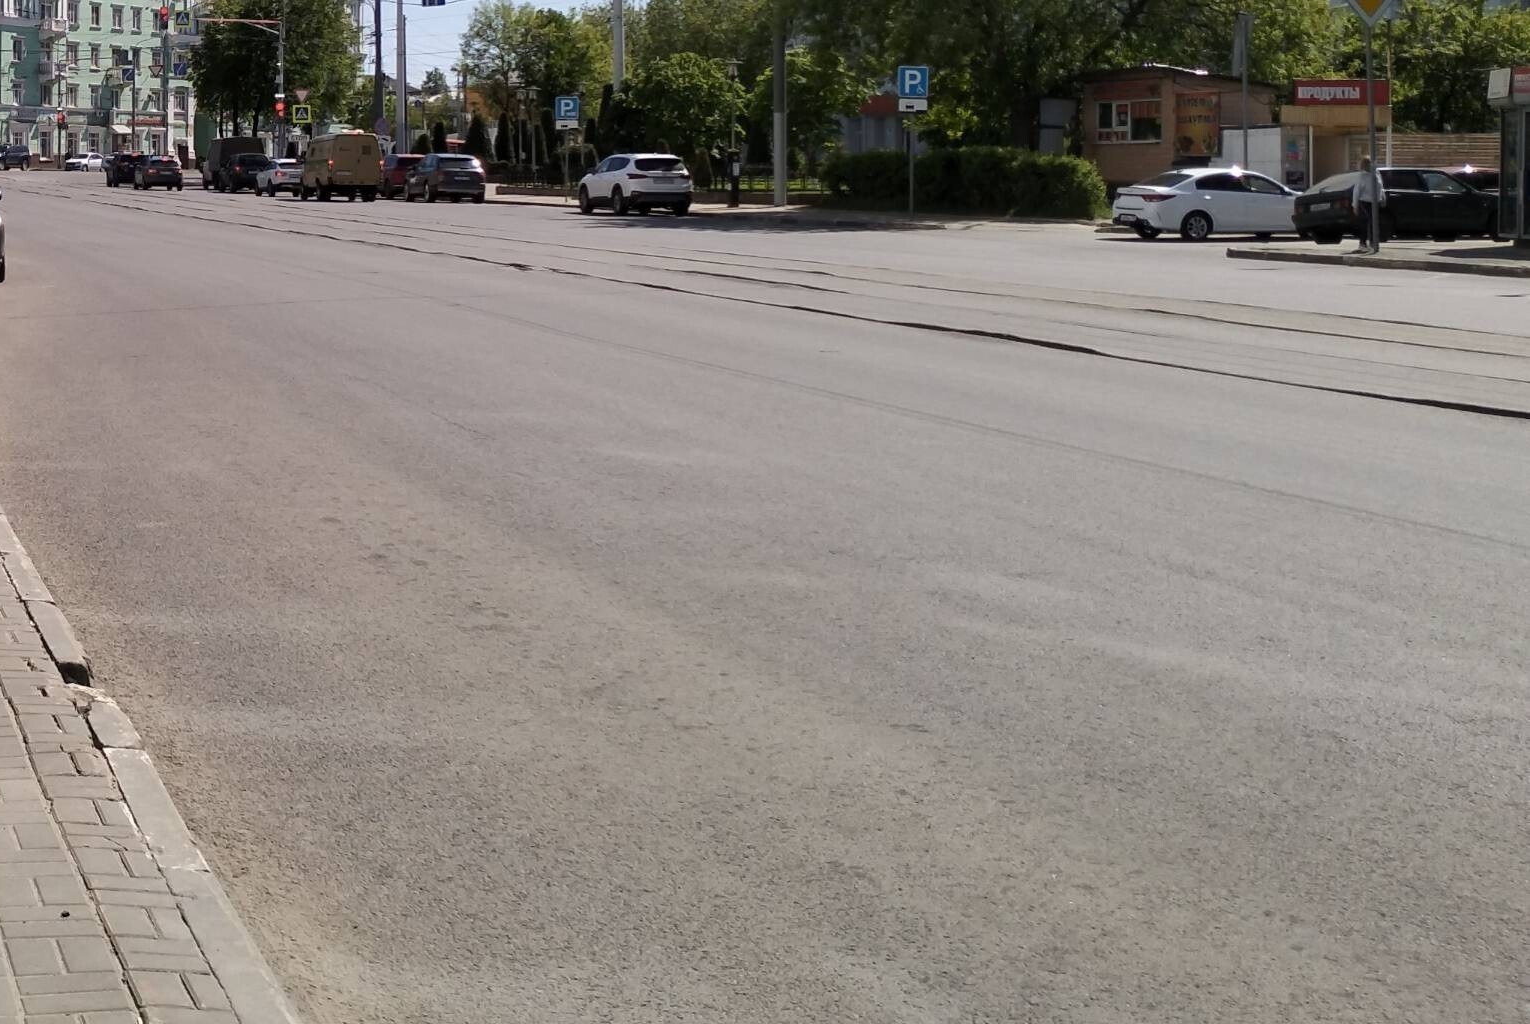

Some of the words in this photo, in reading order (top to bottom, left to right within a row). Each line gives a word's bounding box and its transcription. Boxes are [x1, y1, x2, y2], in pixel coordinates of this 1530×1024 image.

[905, 70, 921, 93] P
[1298, 86, 1360, 101] ПРОДУКТЫ
[560, 100, 574, 116] P
